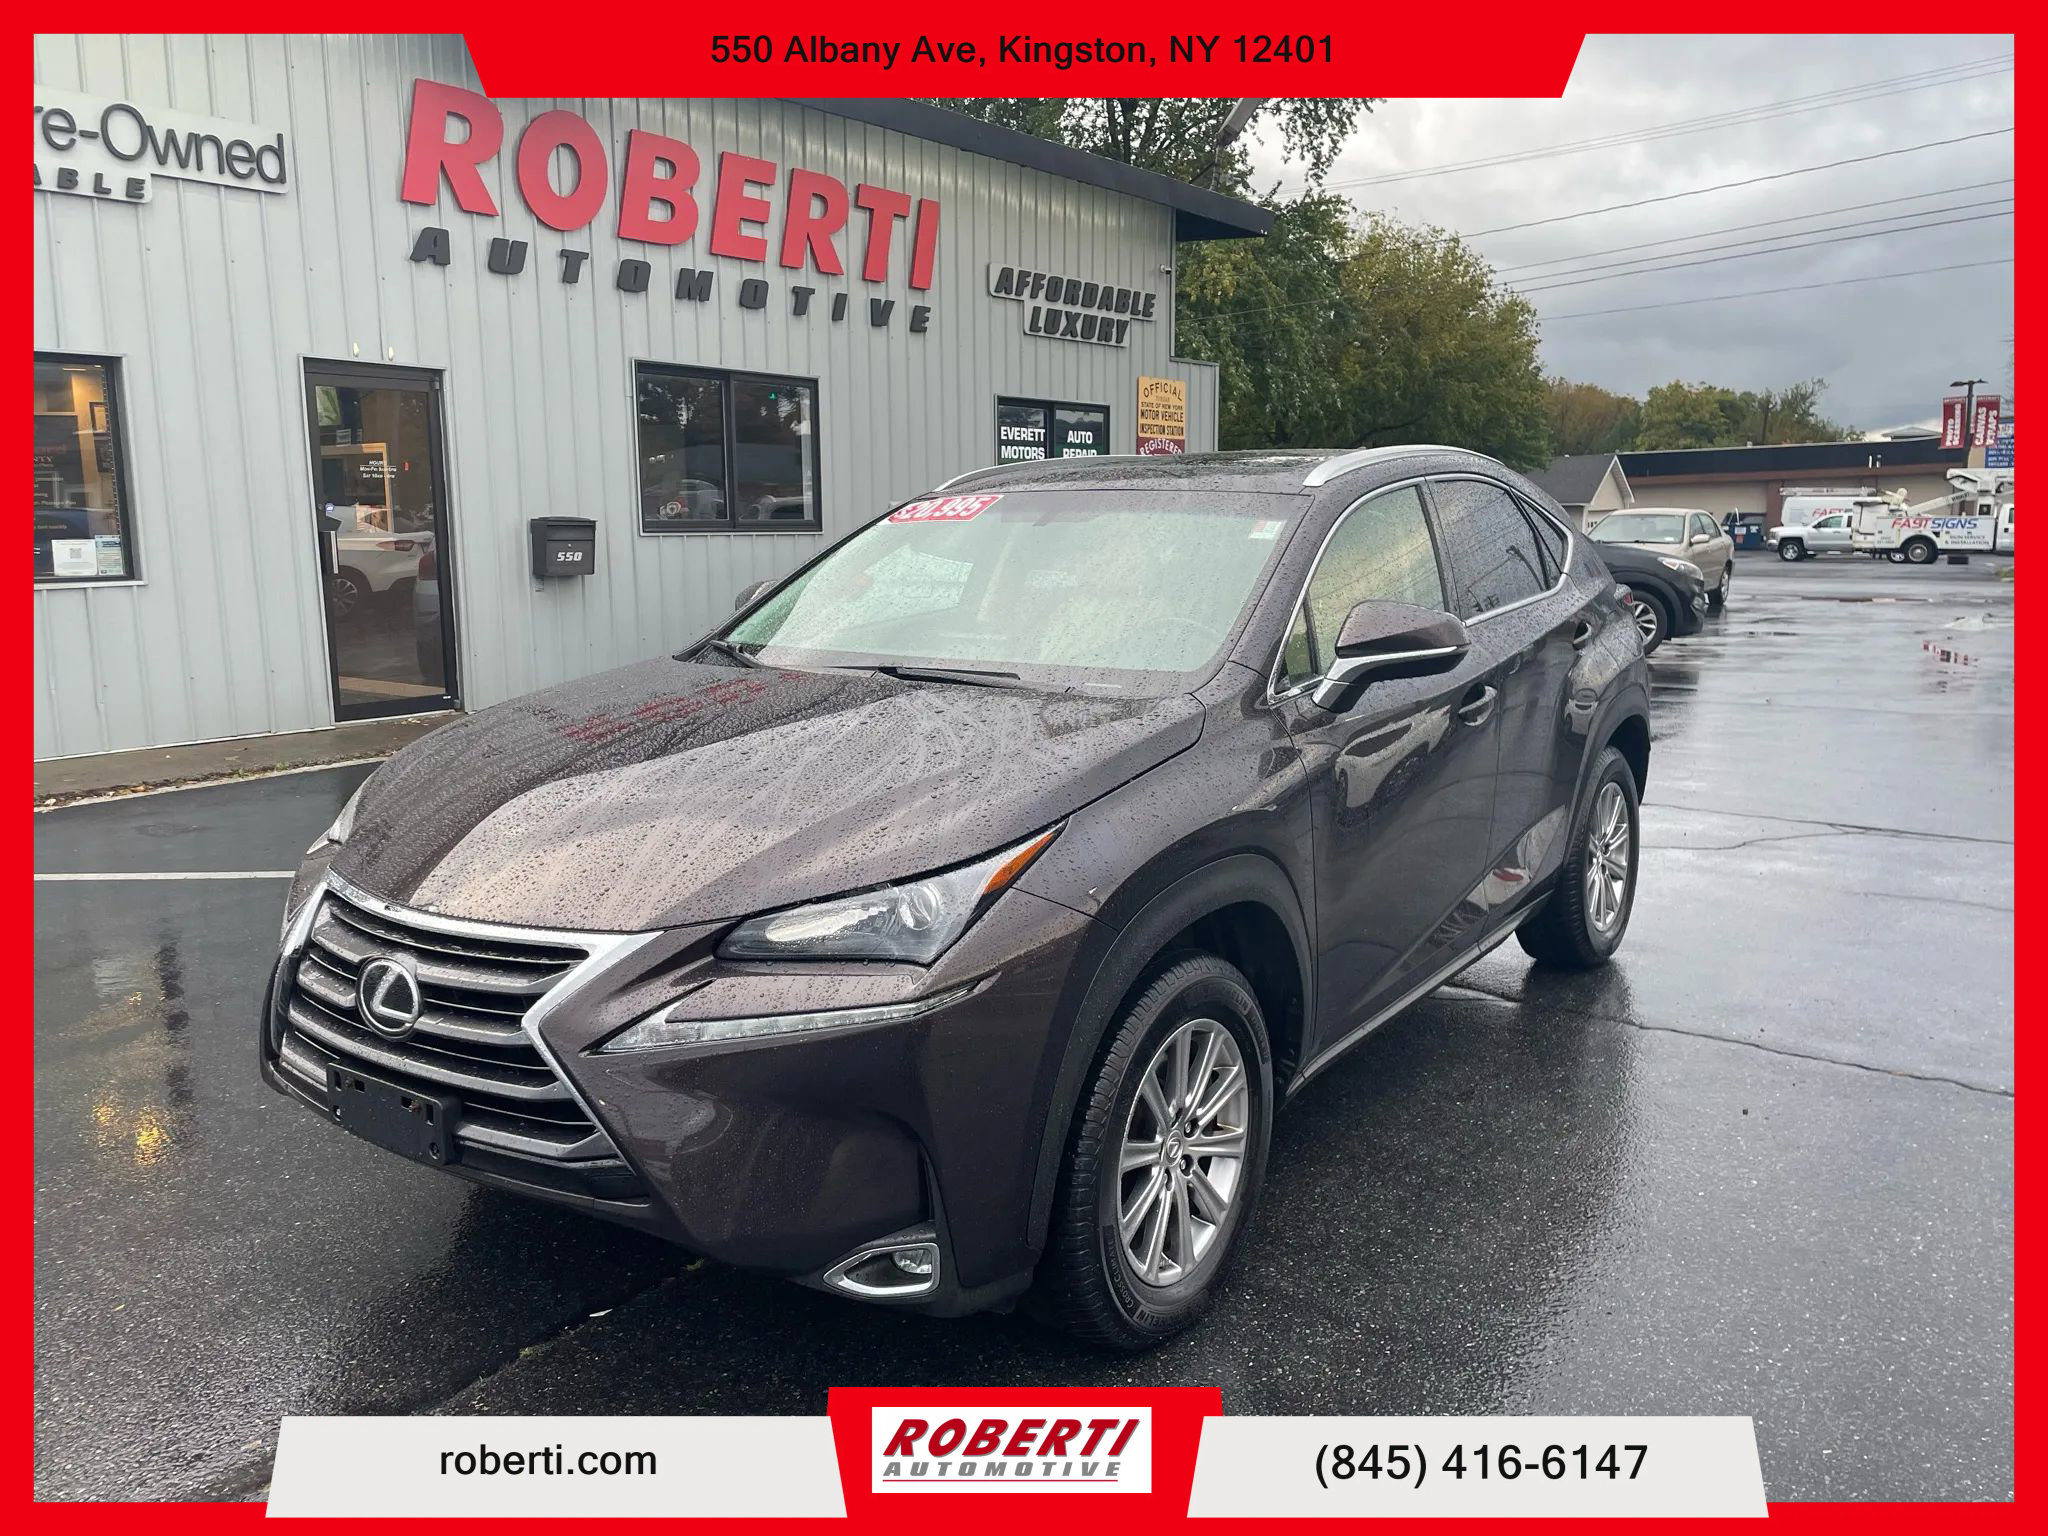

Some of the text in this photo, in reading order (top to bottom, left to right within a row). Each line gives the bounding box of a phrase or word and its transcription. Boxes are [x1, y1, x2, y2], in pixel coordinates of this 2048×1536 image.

[34, 103, 287, 185] e-Owned
[400, 78, 940, 291] ROBERTI
[409, 226, 933, 334] AUTOMOTIVE
[994, 266, 1157, 318] AFFORDABLE
[1029, 305, 1130, 345] LUXURY
[1143, 382, 1183, 402] OFFICIAL
[1140, 409, 1184, 423] MOTOR VEHICLE
[1975, 406, 1987, 446] CANVAS
[1000, 426, 1046, 442] EVERETT
[1067, 430, 1093, 444] AUTO
[1139, 423, 1184, 436] INSPECTION STATION
[1001, 445, 1046, 460] MOTORS
[556, 551, 583, 562] 550
